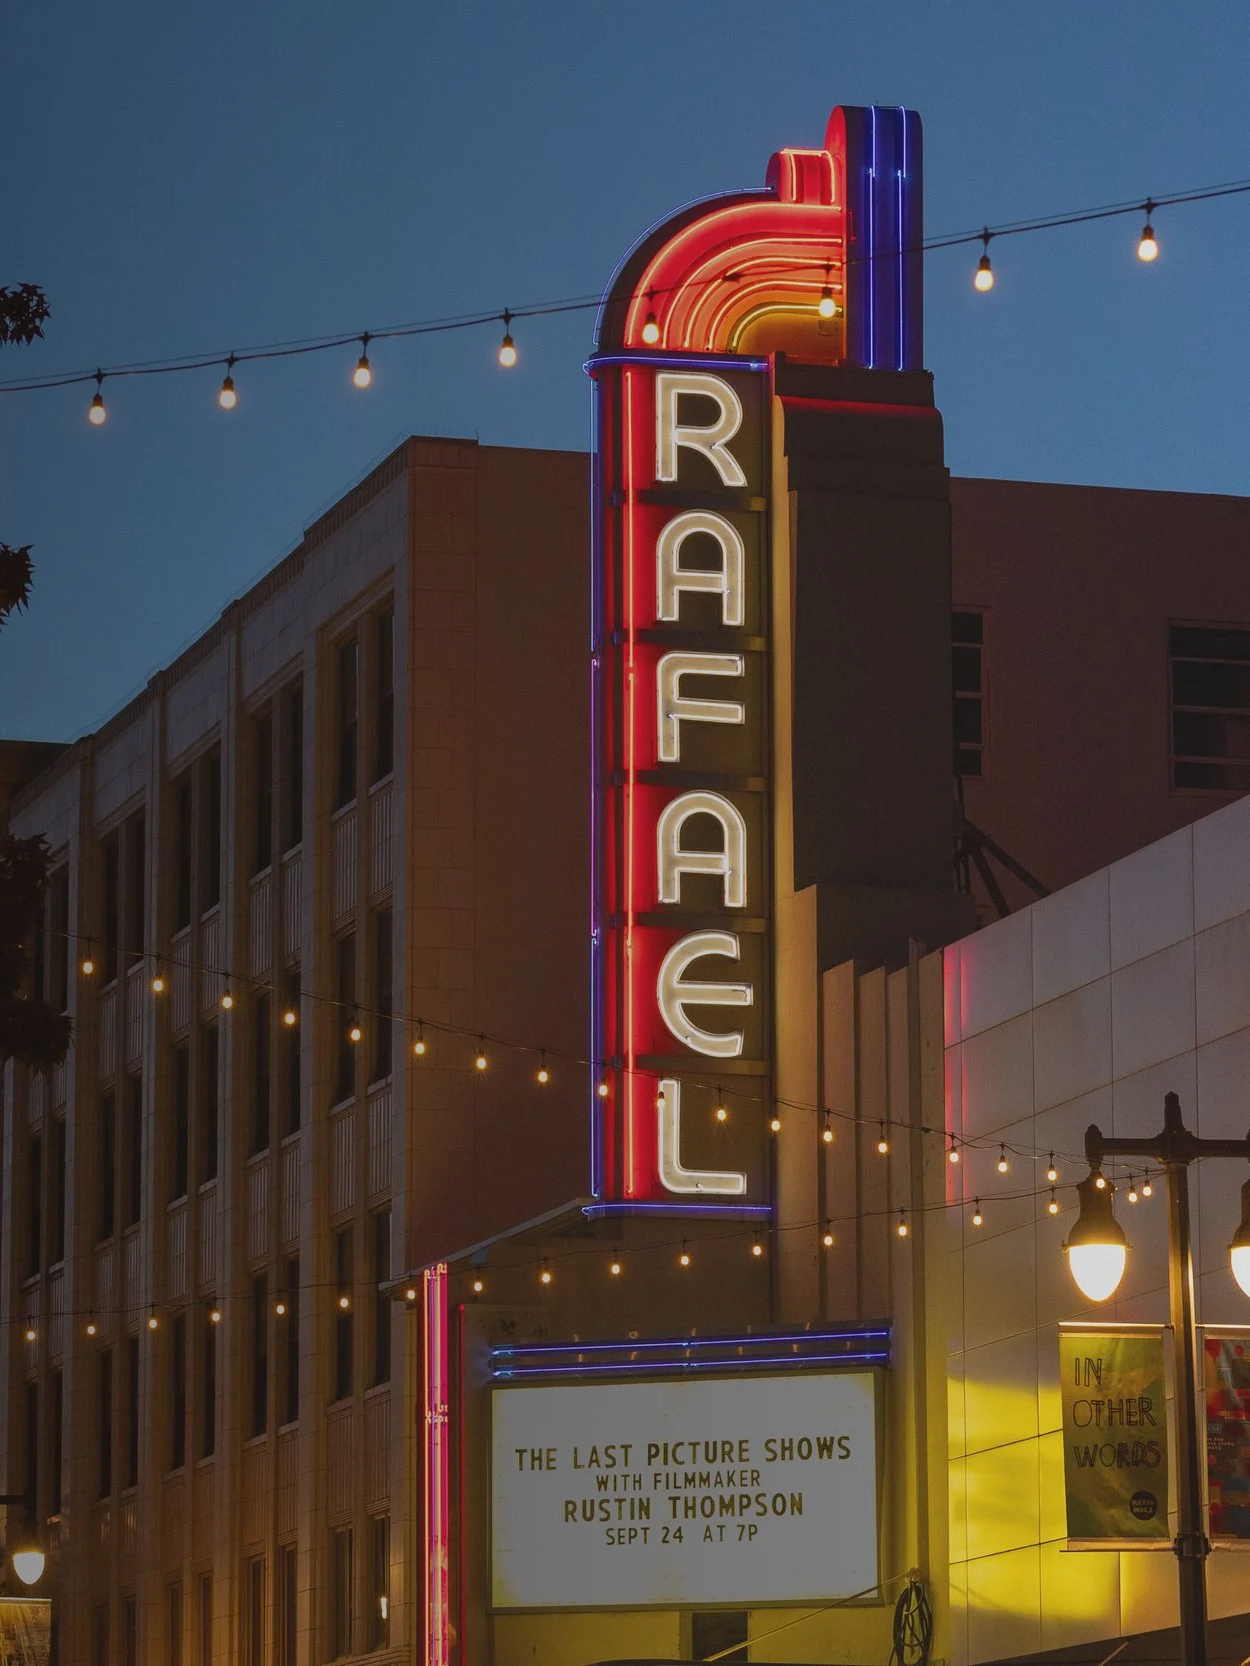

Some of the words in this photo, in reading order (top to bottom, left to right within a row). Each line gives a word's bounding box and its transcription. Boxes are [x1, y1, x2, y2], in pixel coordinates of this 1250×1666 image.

[655, 369, 754, 1196] RAFAEL
[1074, 1357, 1103, 1388] IN
[1072, 1396, 1158, 1428] OTHER
[514, 1447, 558, 1472] THE
[573, 1444, 633, 1470] LAST
[647, 1439, 751, 1467] PICTURE
[764, 1435, 851, 1463] SHOWS
[1073, 1440, 1162, 1469] WORDS
[595, 1473, 642, 1493] WITH
[653, 1468, 761, 1491] FILMMAKER
[564, 1496, 651, 1523] RUSTIN
[667, 1492, 803, 1520] THOMPSON
[605, 1526, 651, 1546] SEPT
[661, 1525, 684, 1545] 24
[702, 1524, 727, 1543] AT
[736, 1523, 759, 1543] 7P
